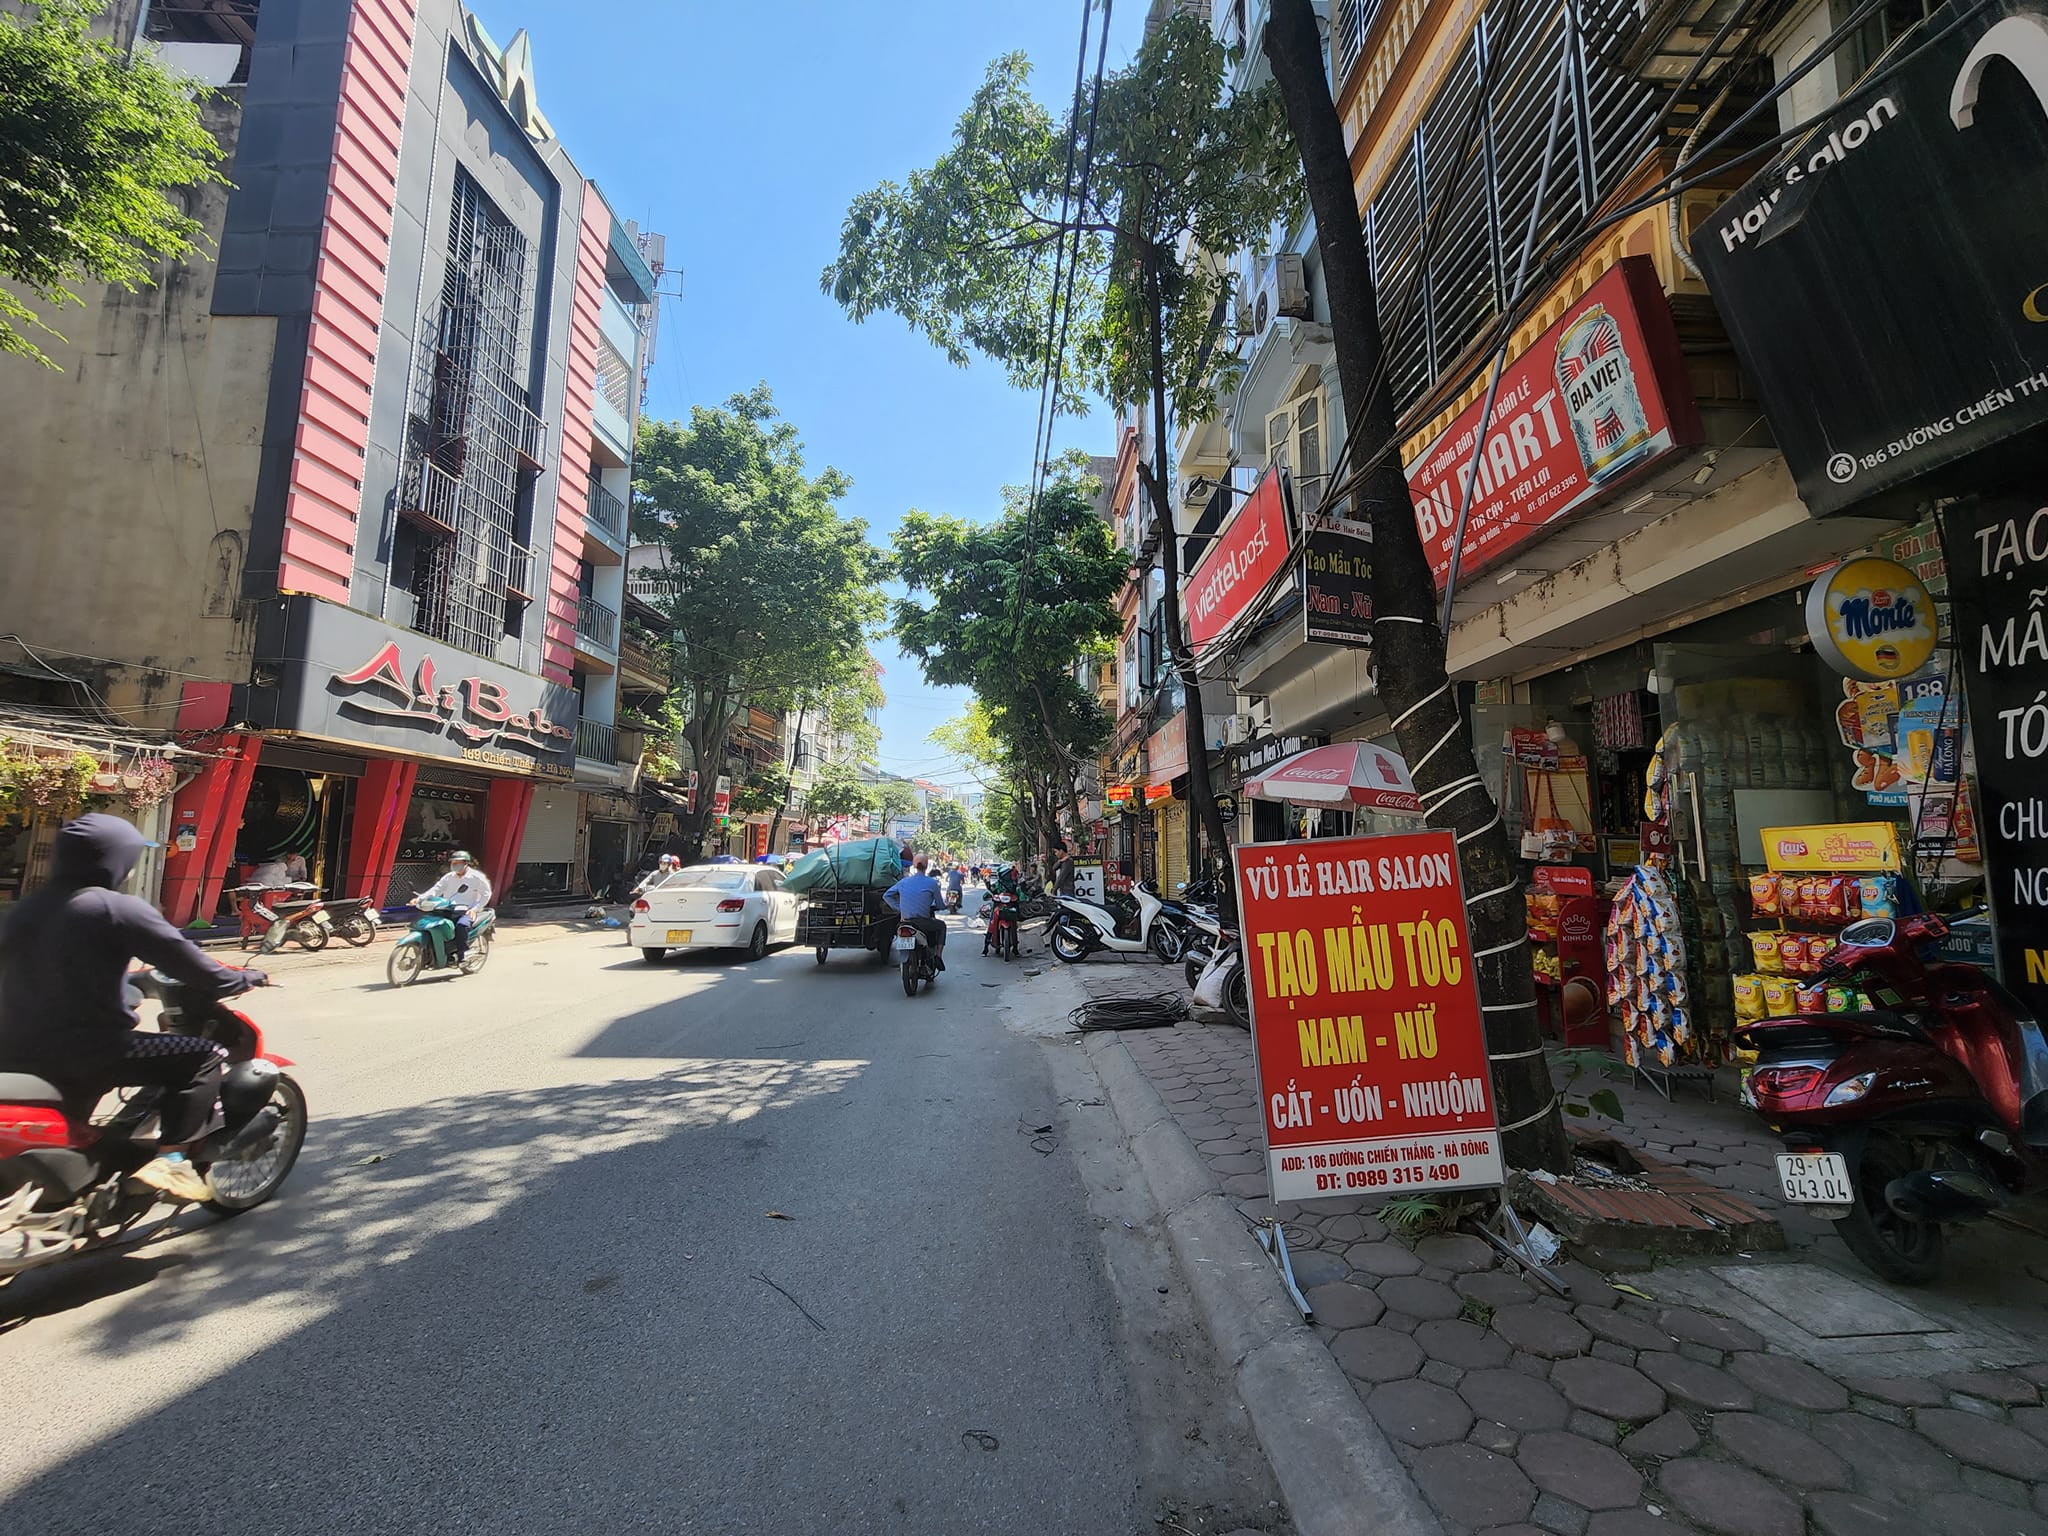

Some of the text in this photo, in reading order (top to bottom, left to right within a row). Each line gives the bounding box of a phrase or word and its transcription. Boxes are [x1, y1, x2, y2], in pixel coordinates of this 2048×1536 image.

[1720, 187, 1782, 253] Hair
[1570, 381, 1593, 413] BIA
[1590, 357, 1622, 394] VIỆT
[1455, 430, 1474, 456] BÁN
[1496, 391, 1517, 419] BÁN
[1859, 365, 2048, 471] 186 ĐƯỜNG CHIẾN TH
[1414, 388, 1561, 543] BU MART
[1509, 485, 1533, 504] TIỆN
[1306, 548, 1373, 580] Tạo Mẫu Tóc
[1307, 585, 1341, 615] Nam
[1840, 598, 1915, 639] Monte
[460, 676, 573, 740] Baba
[1905, 680, 1944, 701] 188
[462, 748, 480, 760] 169
[482, 751, 511, 765] Chiến
[1780, 841, 1808, 856] Lay's
[1075, 885, 1096, 897] ÓC
[1246, 852, 1452, 901] VŨ LÊ HAIR SALON
[1257, 905, 1462, 1010] TẠO MẪU TÓC
[1297, 1015, 1368, 1068] NAM
[1394, 1002, 1438, 1060] NỮ
[1271, 1078, 1312, 1129] CẮT
[1334, 1075, 1383, 1124] UỐN
[1402, 1071, 1486, 1125] NHUỘM
[1281, 1157, 1306, 1173] ADD:
[1307, 1154, 1327, 1170] 186
[1329, 1149, 1365, 1168] ĐƯỜNG
[1367, 1144, 1399, 1165] CHIẾN
[1401, 1140, 1435, 1162] THẮNG
[1444, 1143, 1459, 1159] HÀ
[1460, 1139, 1490, 1156] ĐÔNG
[1316, 1163, 1460, 1190] ĐT: 0989 315 490
[1787, 1179, 1851, 1201] 943.04
